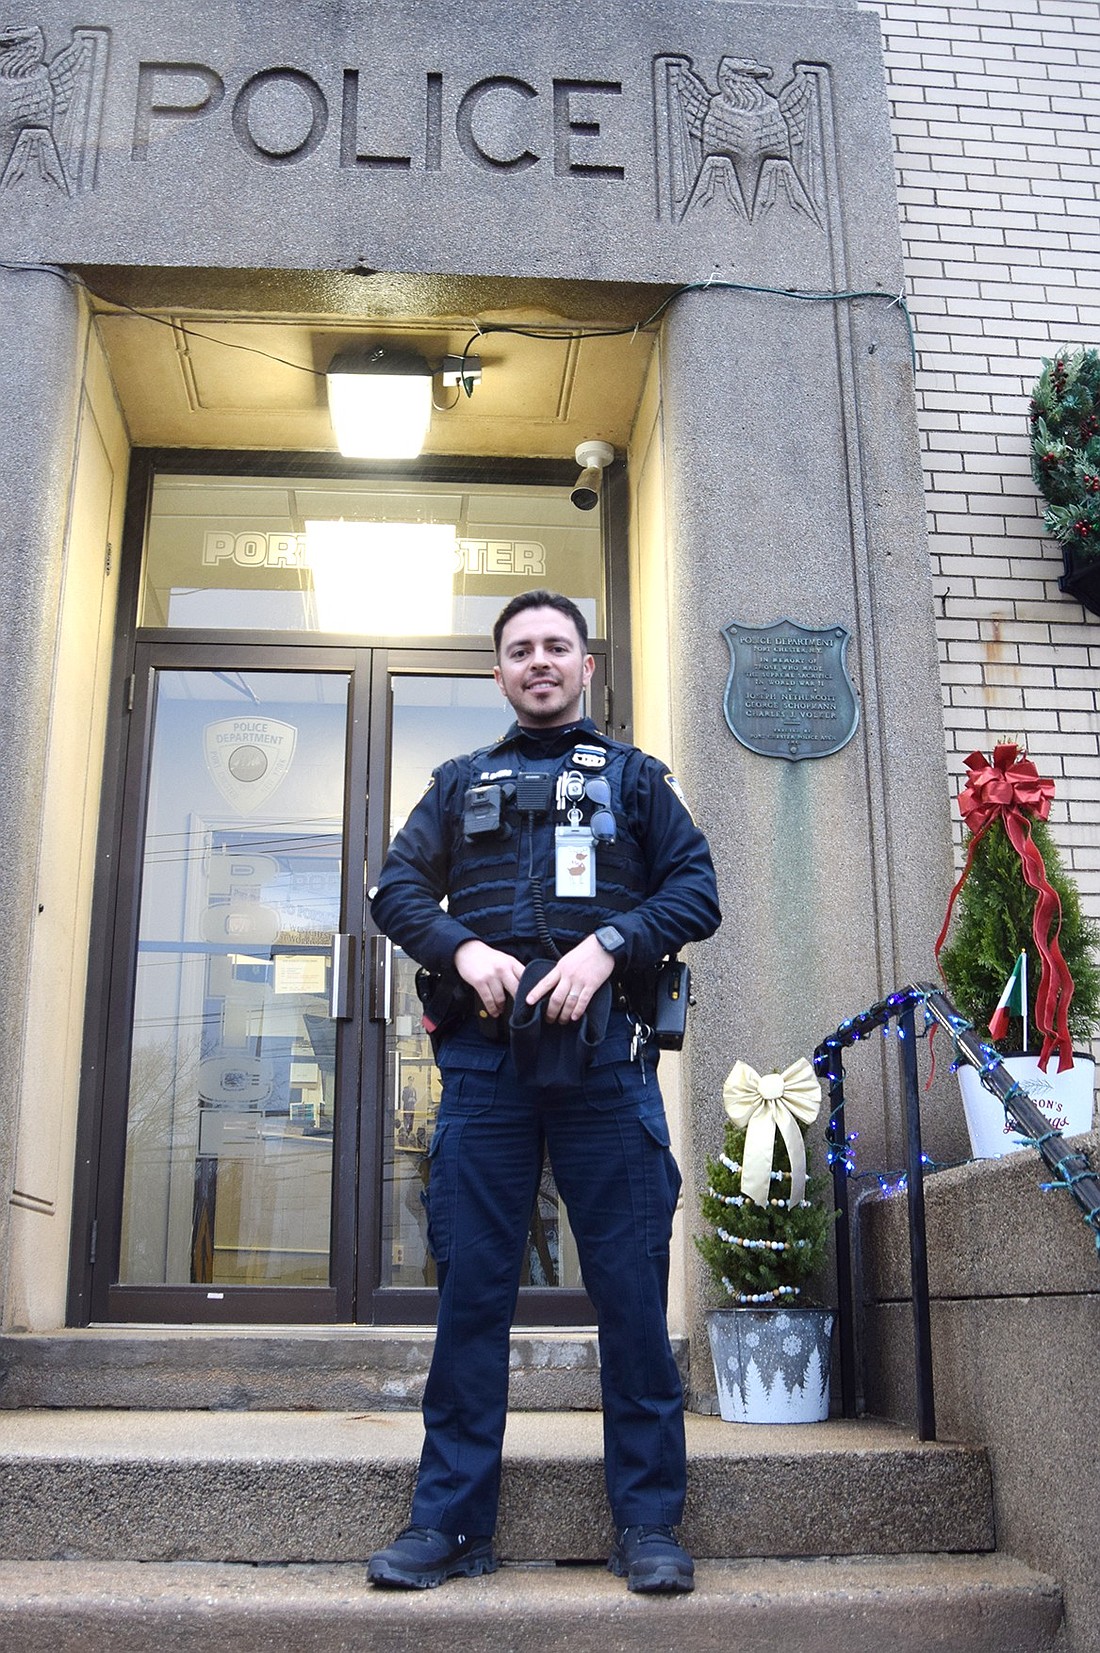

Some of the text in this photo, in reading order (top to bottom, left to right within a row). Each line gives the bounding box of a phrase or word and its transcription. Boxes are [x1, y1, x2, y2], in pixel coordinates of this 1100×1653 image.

[131, 61, 624, 180] POLICE
[450, 537, 546, 576] STER
[740, 636, 834, 647] POLICE DEPARTMENT
[745, 692, 776, 700] JOSEPH
[233, 722, 269, 733] POLICE
[215, 733, 284, 745] DEPARTMENT
[1031, 1098, 1063, 1112] SON'S
